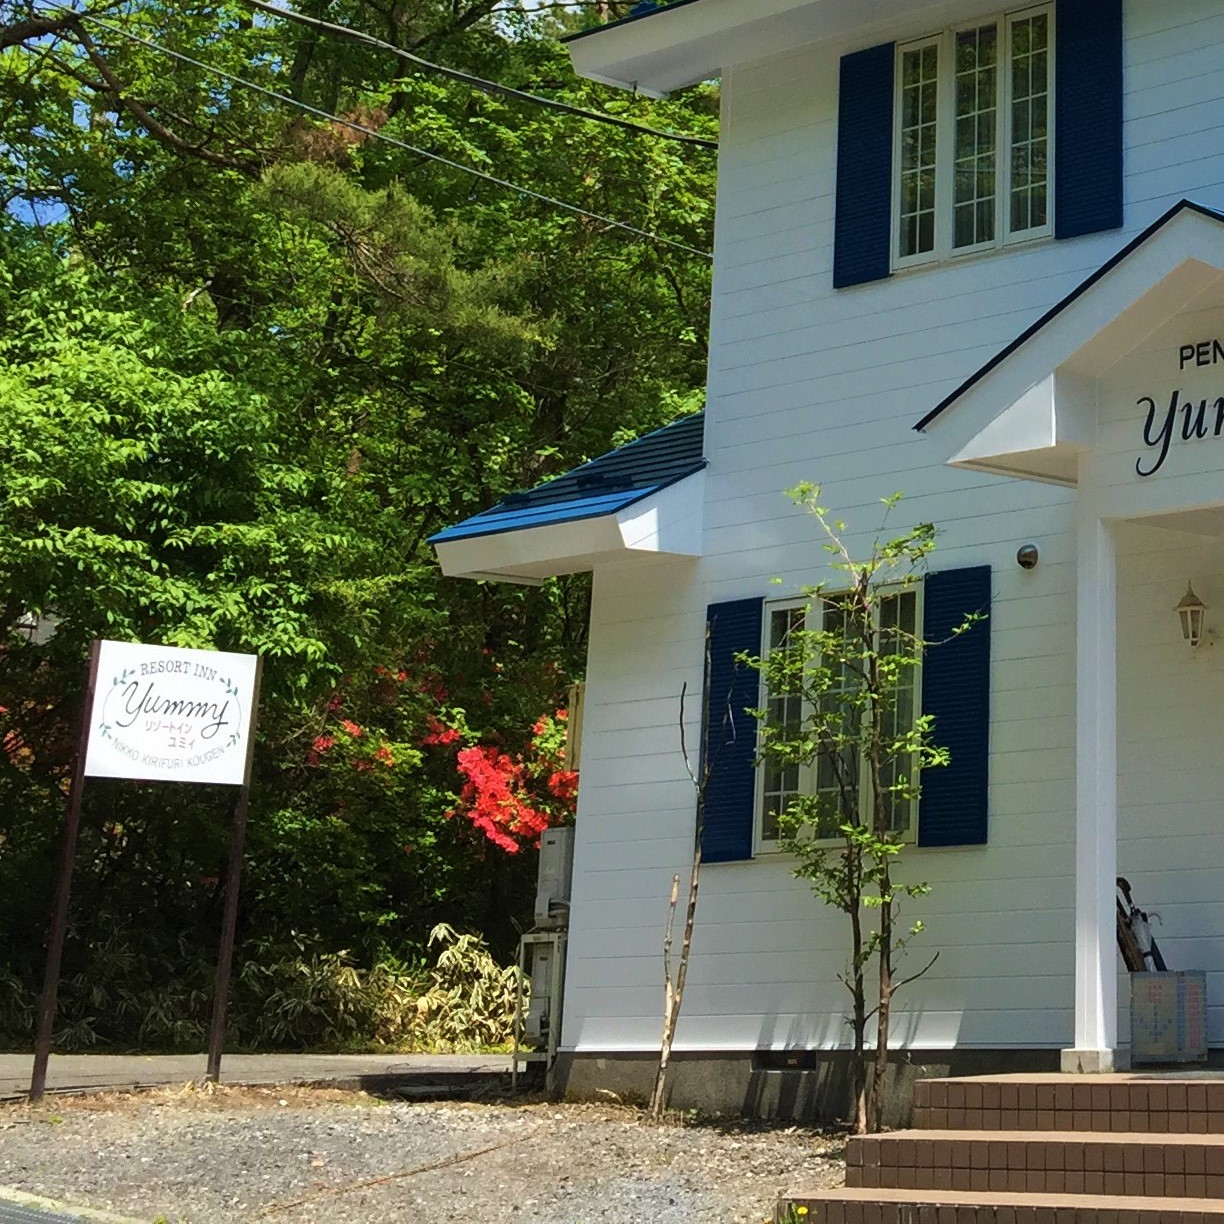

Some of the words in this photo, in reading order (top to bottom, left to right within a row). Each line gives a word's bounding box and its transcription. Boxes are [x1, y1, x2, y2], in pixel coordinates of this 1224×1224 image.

[140, 659, 191, 676] RESORT
[194, 663, 218, 682] INN
[115, 680, 230, 740] Yummy
[112, 737, 139, 761] NIKKO
[141, 754, 183, 769] KIRIFURI
[187, 746, 225, 768] KOUGEN
